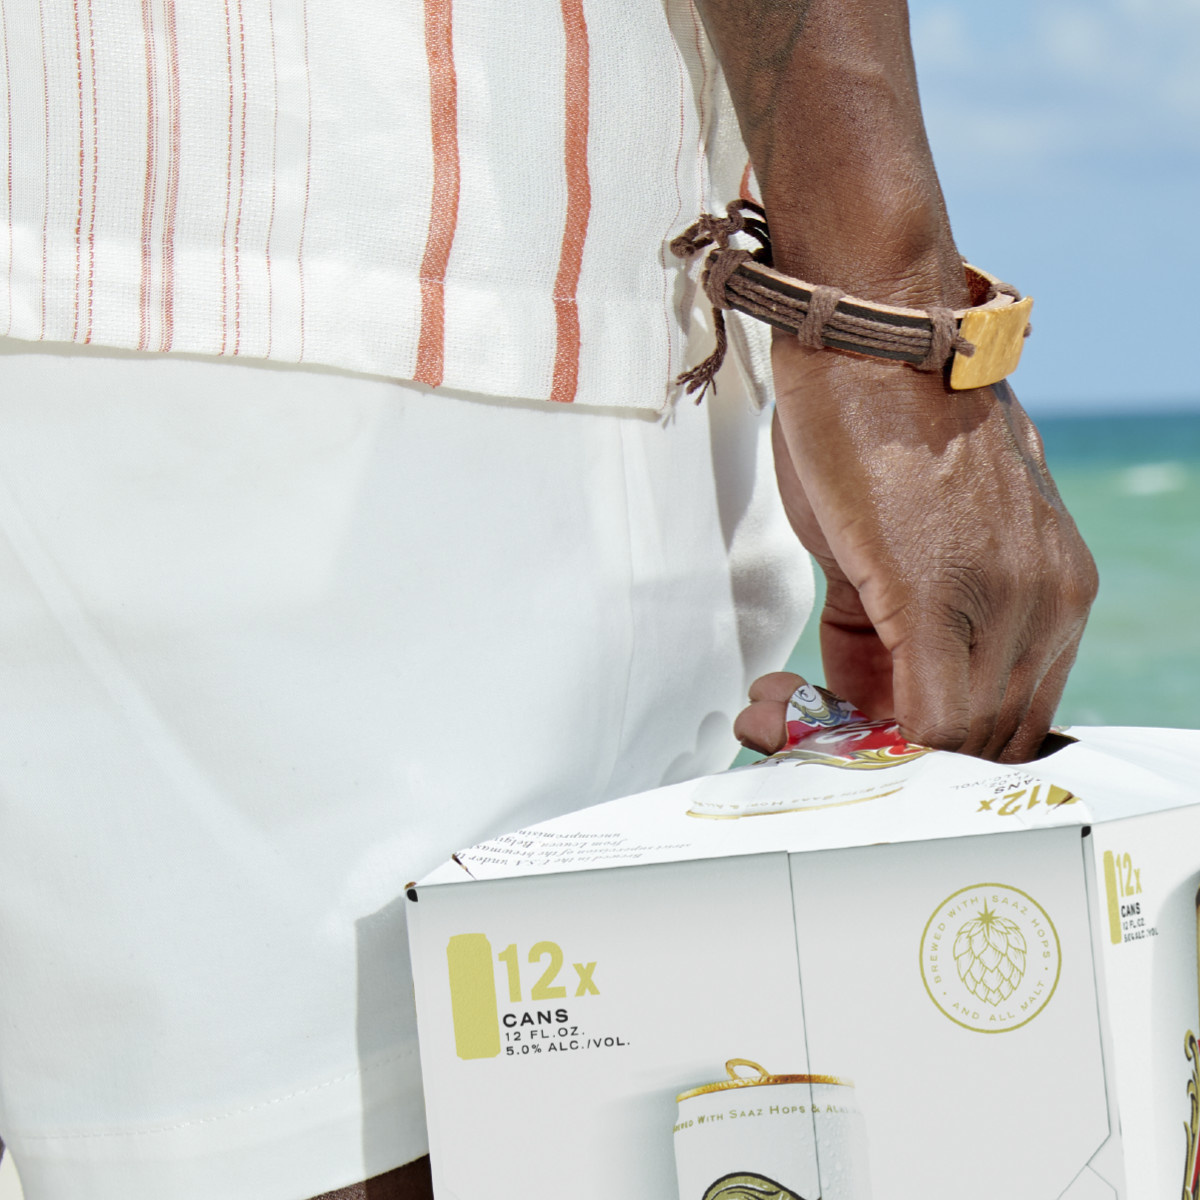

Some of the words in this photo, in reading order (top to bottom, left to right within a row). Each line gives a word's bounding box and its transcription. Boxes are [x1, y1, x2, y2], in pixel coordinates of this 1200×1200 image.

[976, 784, 1041, 816] 12x
[1116, 851, 1142, 897] 12x
[1121, 901, 1141, 918] CANS
[929, 922, 946, 983] BREWED
[947, 896, 979, 918] WITH
[992, 895, 1028, 915] SAAZ
[1031, 918, 1051, 959] HOPS
[498, 941, 601, 1003] 12x
[952, 1002, 980, 1020] AND
[989, 1011, 1015, 1021] ALL
[1020, 980, 1045, 1011] MALT
[502, 1008, 569, 1028] CANS
[505, 1031, 521, 1042] 12
[506, 1044, 542, 1056] 5.0%
[548, 1036, 631, 1053] ALC./VOL.
